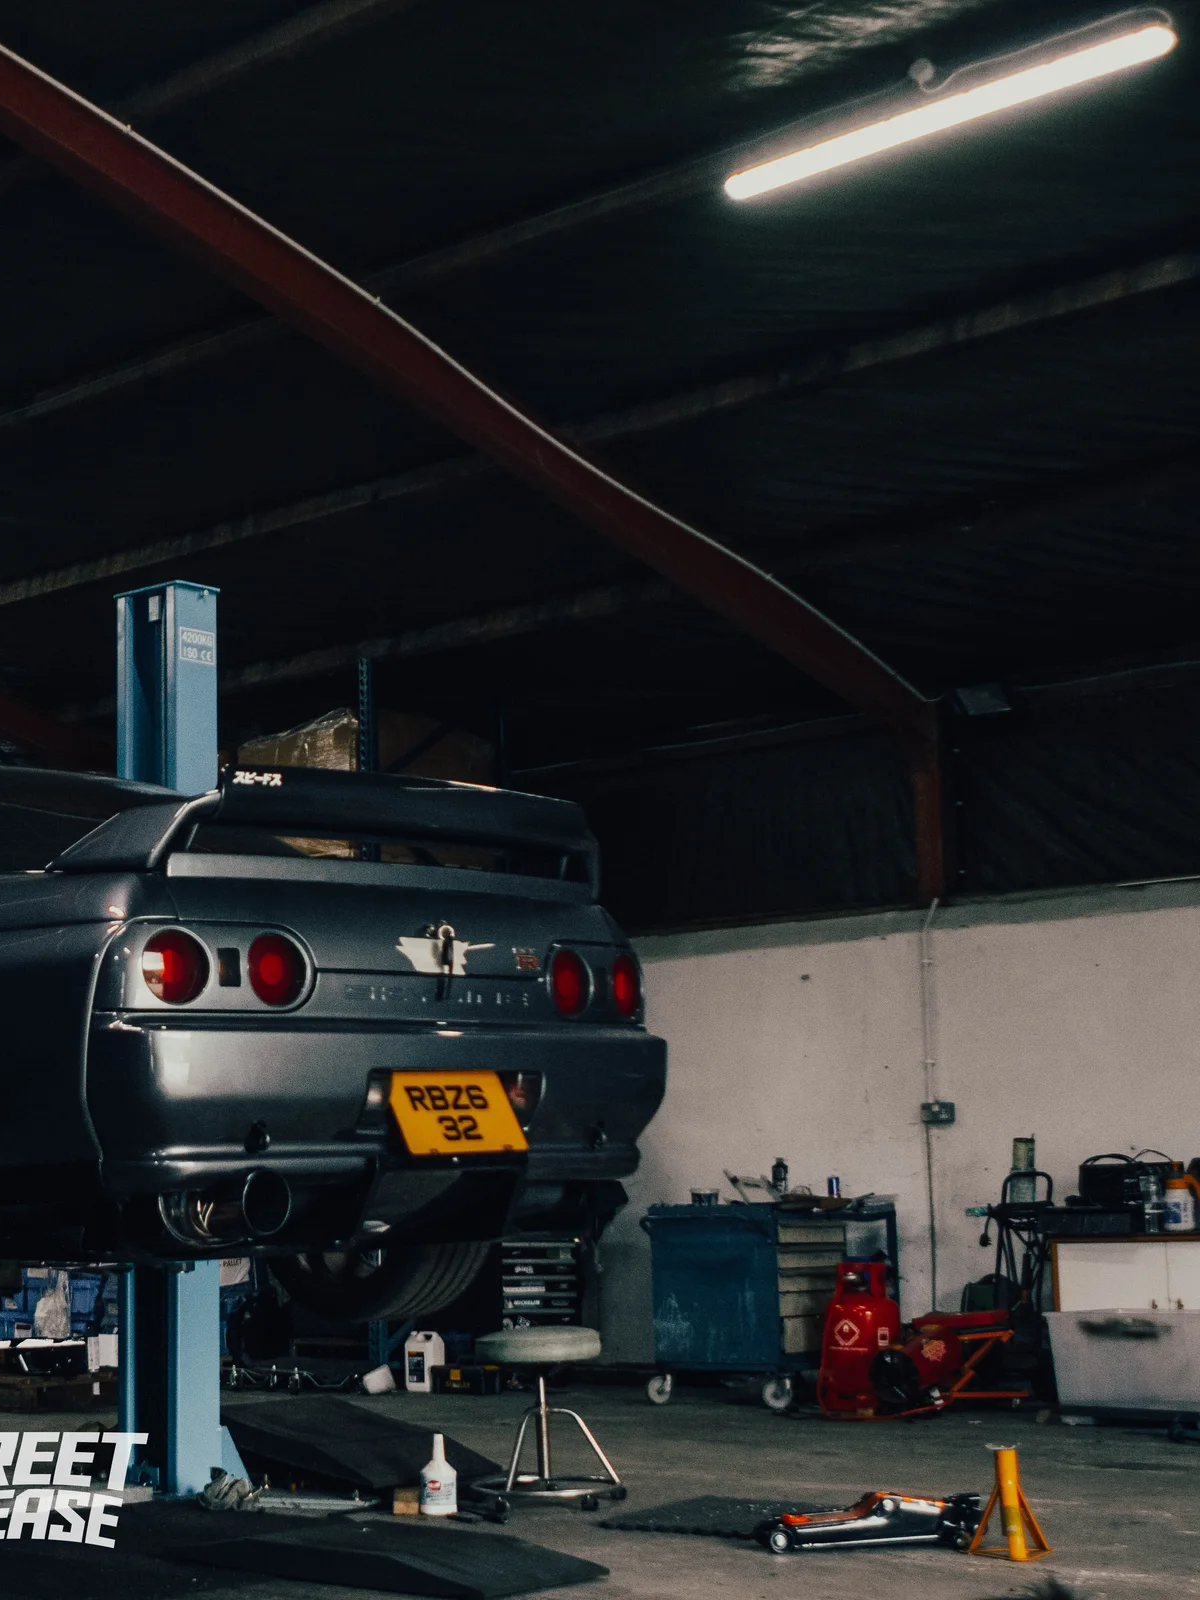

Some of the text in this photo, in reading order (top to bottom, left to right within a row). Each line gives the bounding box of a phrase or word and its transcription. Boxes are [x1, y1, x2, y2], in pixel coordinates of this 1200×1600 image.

[182, 631, 213, 647] 4200KG
[201, 650, 212, 662] CE
[404, 1085, 490, 1111] RBZ6
[438, 1115, 483, 1141] 32
